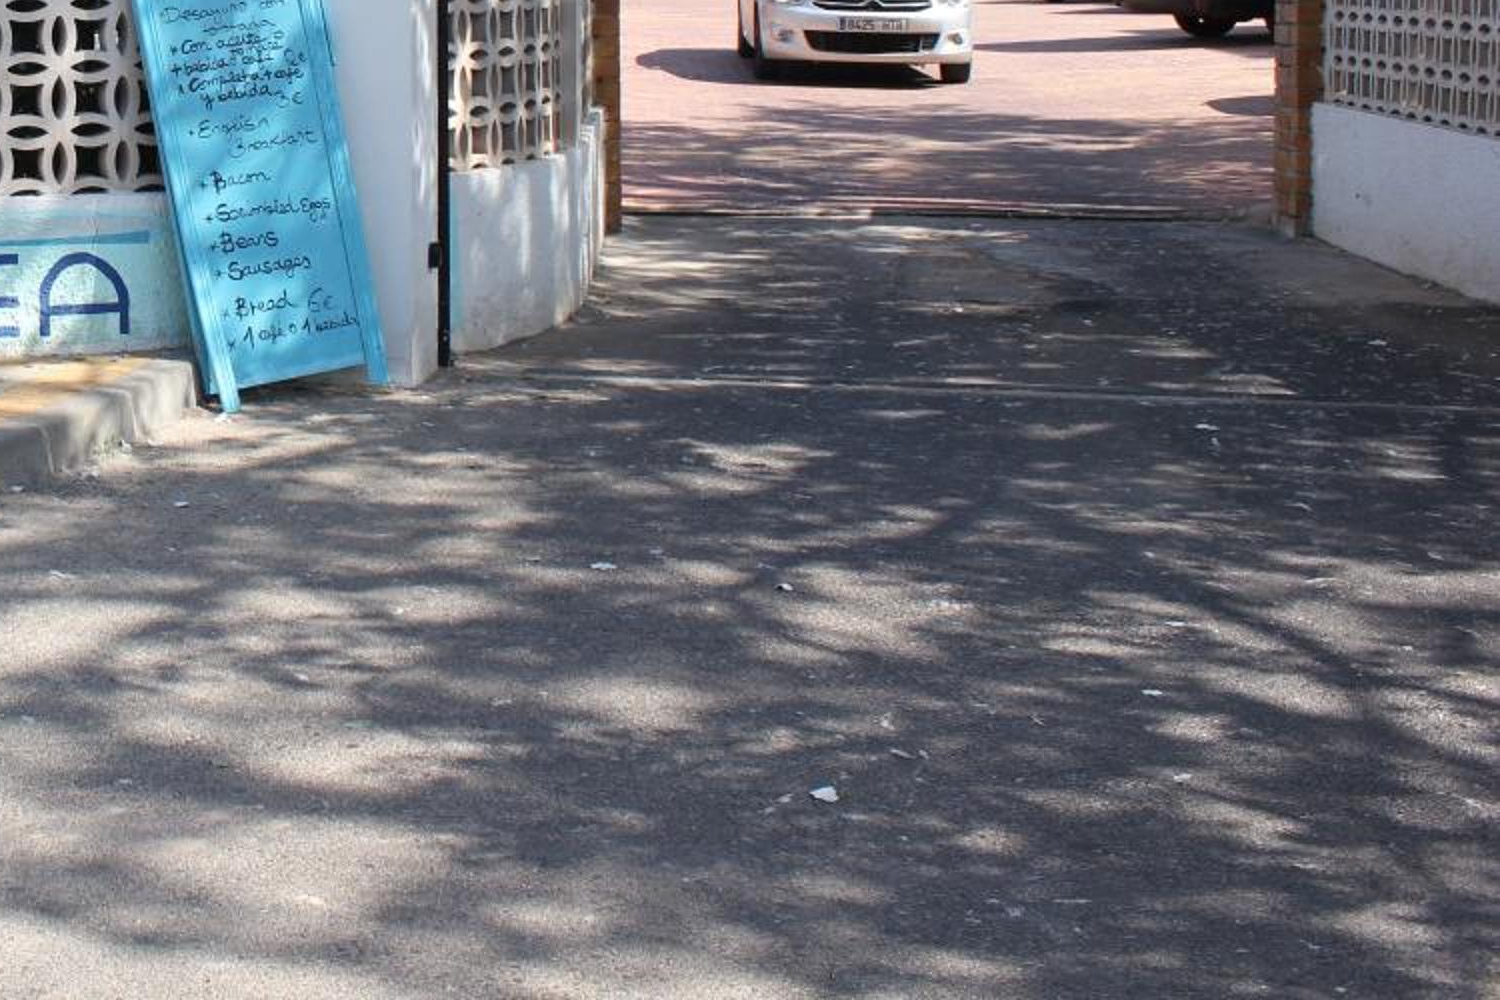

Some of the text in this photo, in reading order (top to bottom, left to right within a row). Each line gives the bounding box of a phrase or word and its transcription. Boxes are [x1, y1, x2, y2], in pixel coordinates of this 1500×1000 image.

[210, 170, 272, 195] Bacon
[227, 255, 312, 281] Sausages
[234, 289, 296, 320] Bread
